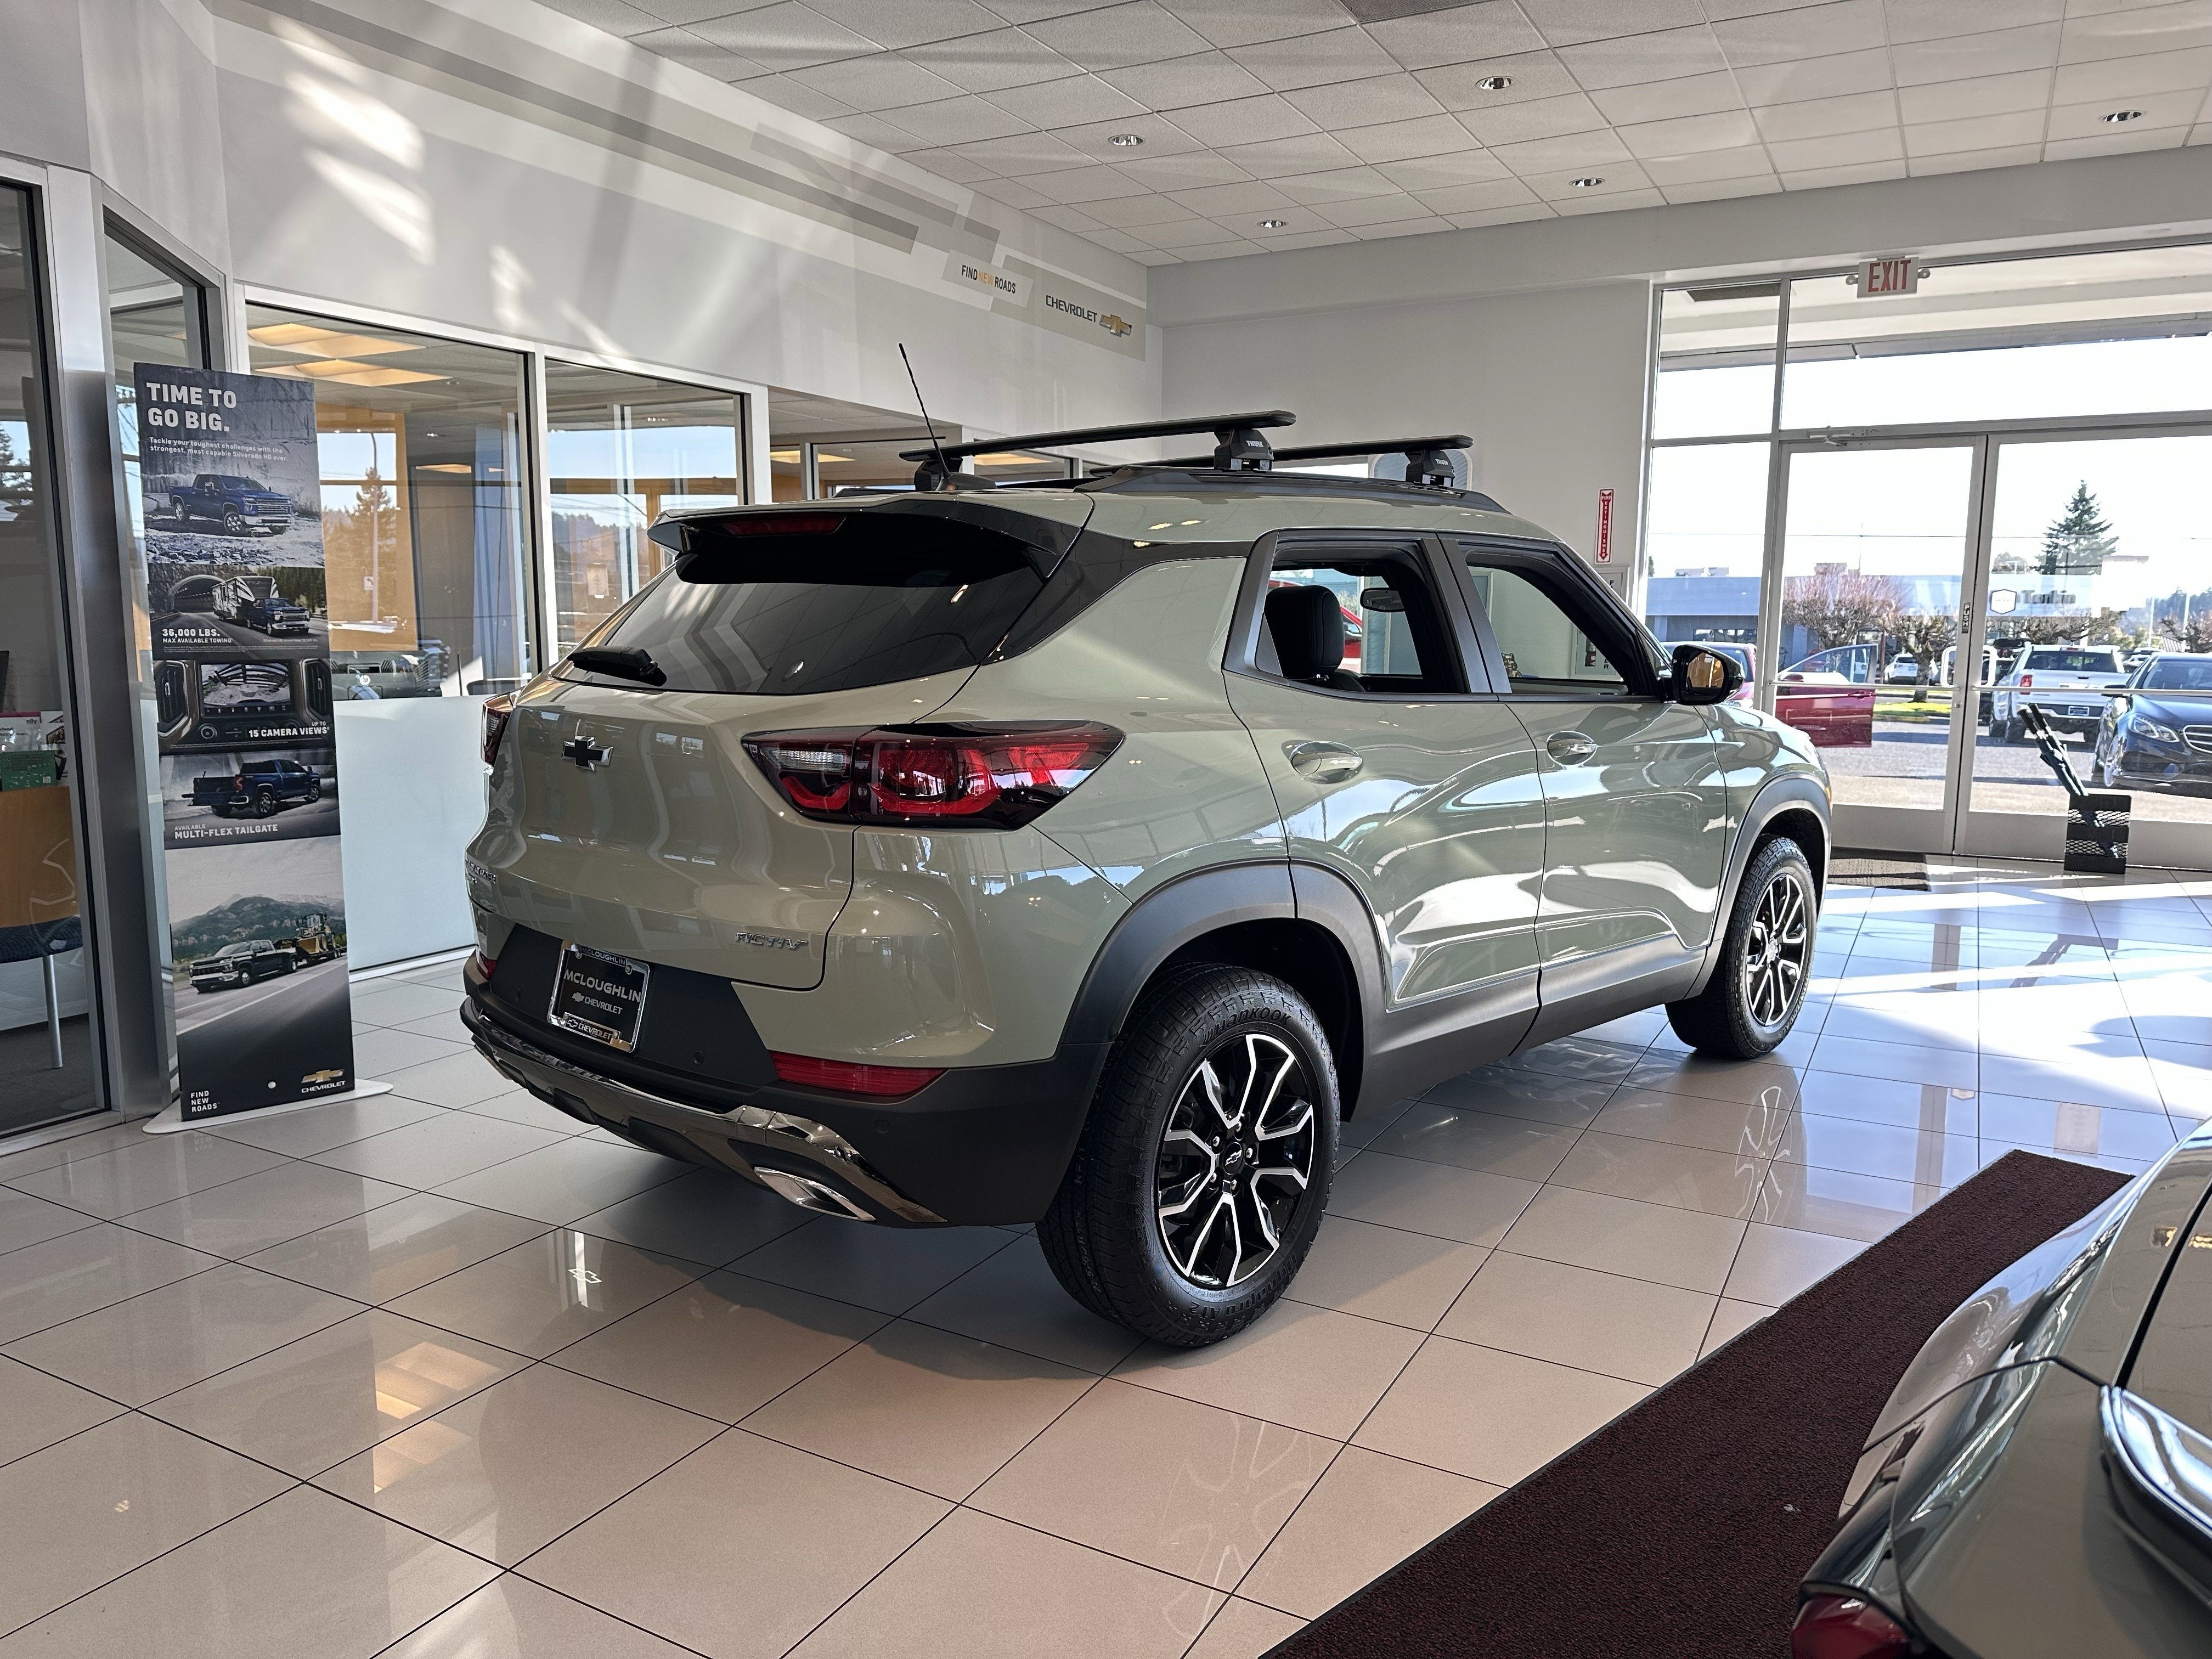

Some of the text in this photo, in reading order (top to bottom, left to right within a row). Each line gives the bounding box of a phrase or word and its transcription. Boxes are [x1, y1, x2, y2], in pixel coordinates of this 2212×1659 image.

[961, 264, 1016, 294] FIND NEW ROADS
[1868, 259, 1911, 292] EXIT
[1045, 295, 1098, 323] CHEVROLET
[146, 382, 236, 409] TIME TO
[148, 408, 229, 432] GO BIG.
[150, 445, 186, 454] strongest,
[233, 451, 262, 459] Silverado
[190, 441, 220, 449] toughest
[222, 443, 256, 452] challenges
[162, 628, 196, 637] 36,000
[249, 730, 259, 738] 15
[261, 728, 297, 737] CAMERA
[174, 824, 278, 839] MULTI-FLEX TAILGATE
[736, 932, 809, 950] ACTIV
[580, 947, 627, 966] MCLOUGHLIN
[564, 968, 641, 1003] MCLOUGHLIN
[584, 996, 623, 1015] CHEVROLET
[578, 1023, 612, 1040] CHEVROLET
[190, 1090, 210, 1099] FIND
[301, 1080, 346, 1093] CHEVROLET
[191, 1097, 209, 1105] NEW
[191, 1103, 218, 1113] ROADS
